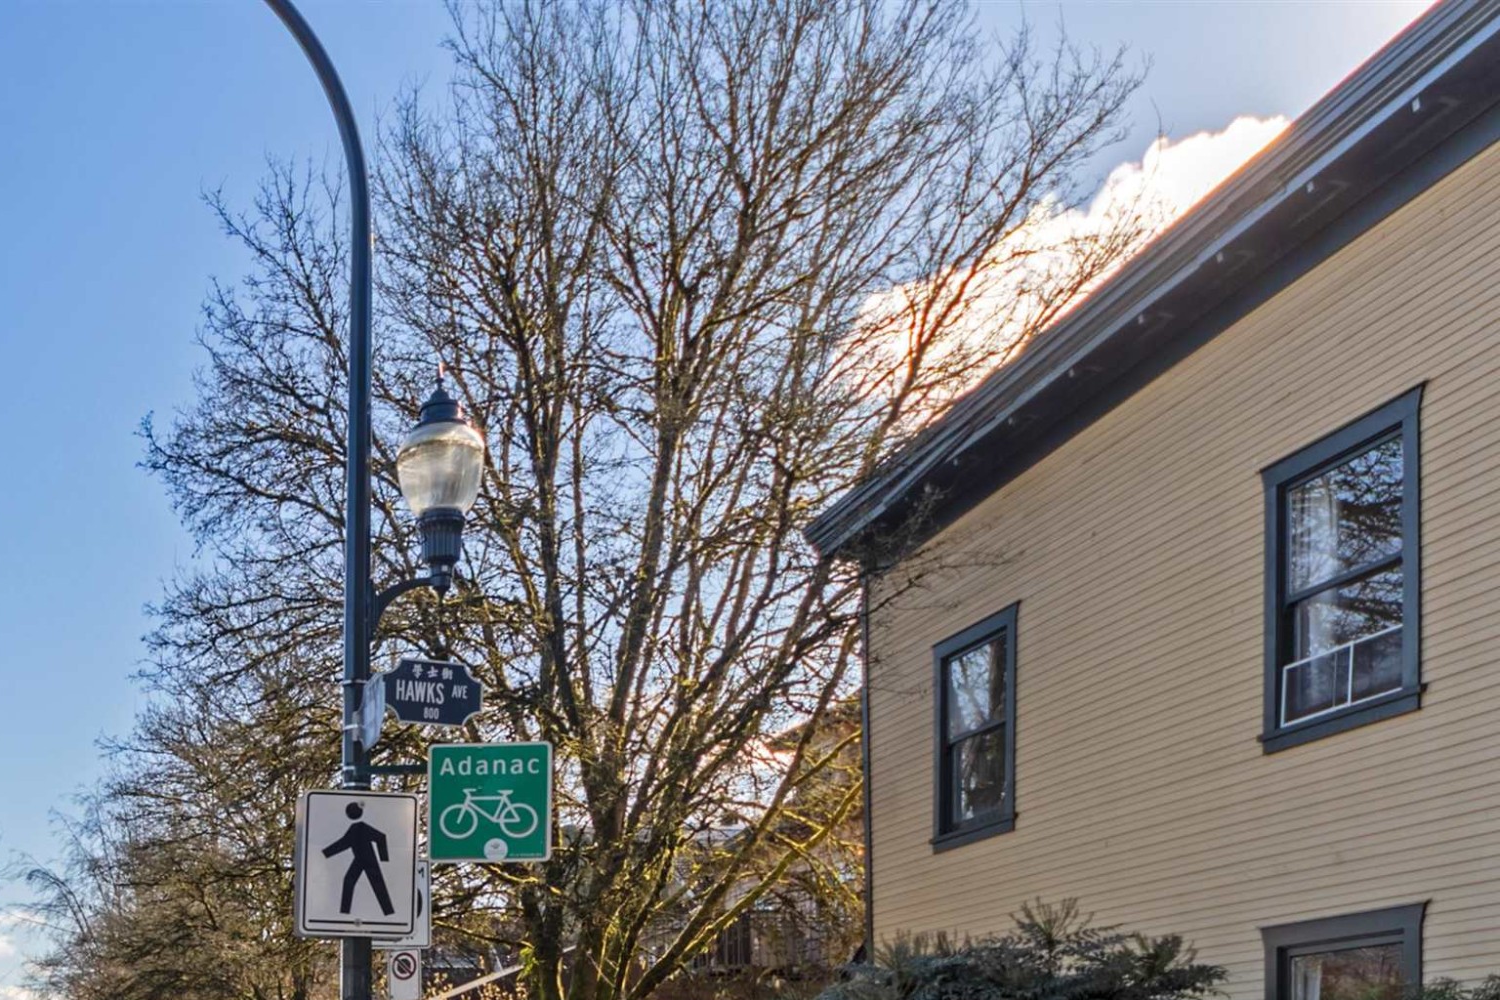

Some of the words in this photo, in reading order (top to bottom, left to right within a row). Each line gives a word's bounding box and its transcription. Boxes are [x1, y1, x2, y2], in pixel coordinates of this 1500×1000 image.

[396, 680, 445, 705] HAWKS
[451, 685, 468, 700] AVE
[423, 707, 440, 720] 800
[440, 756, 540, 776] Adanac
